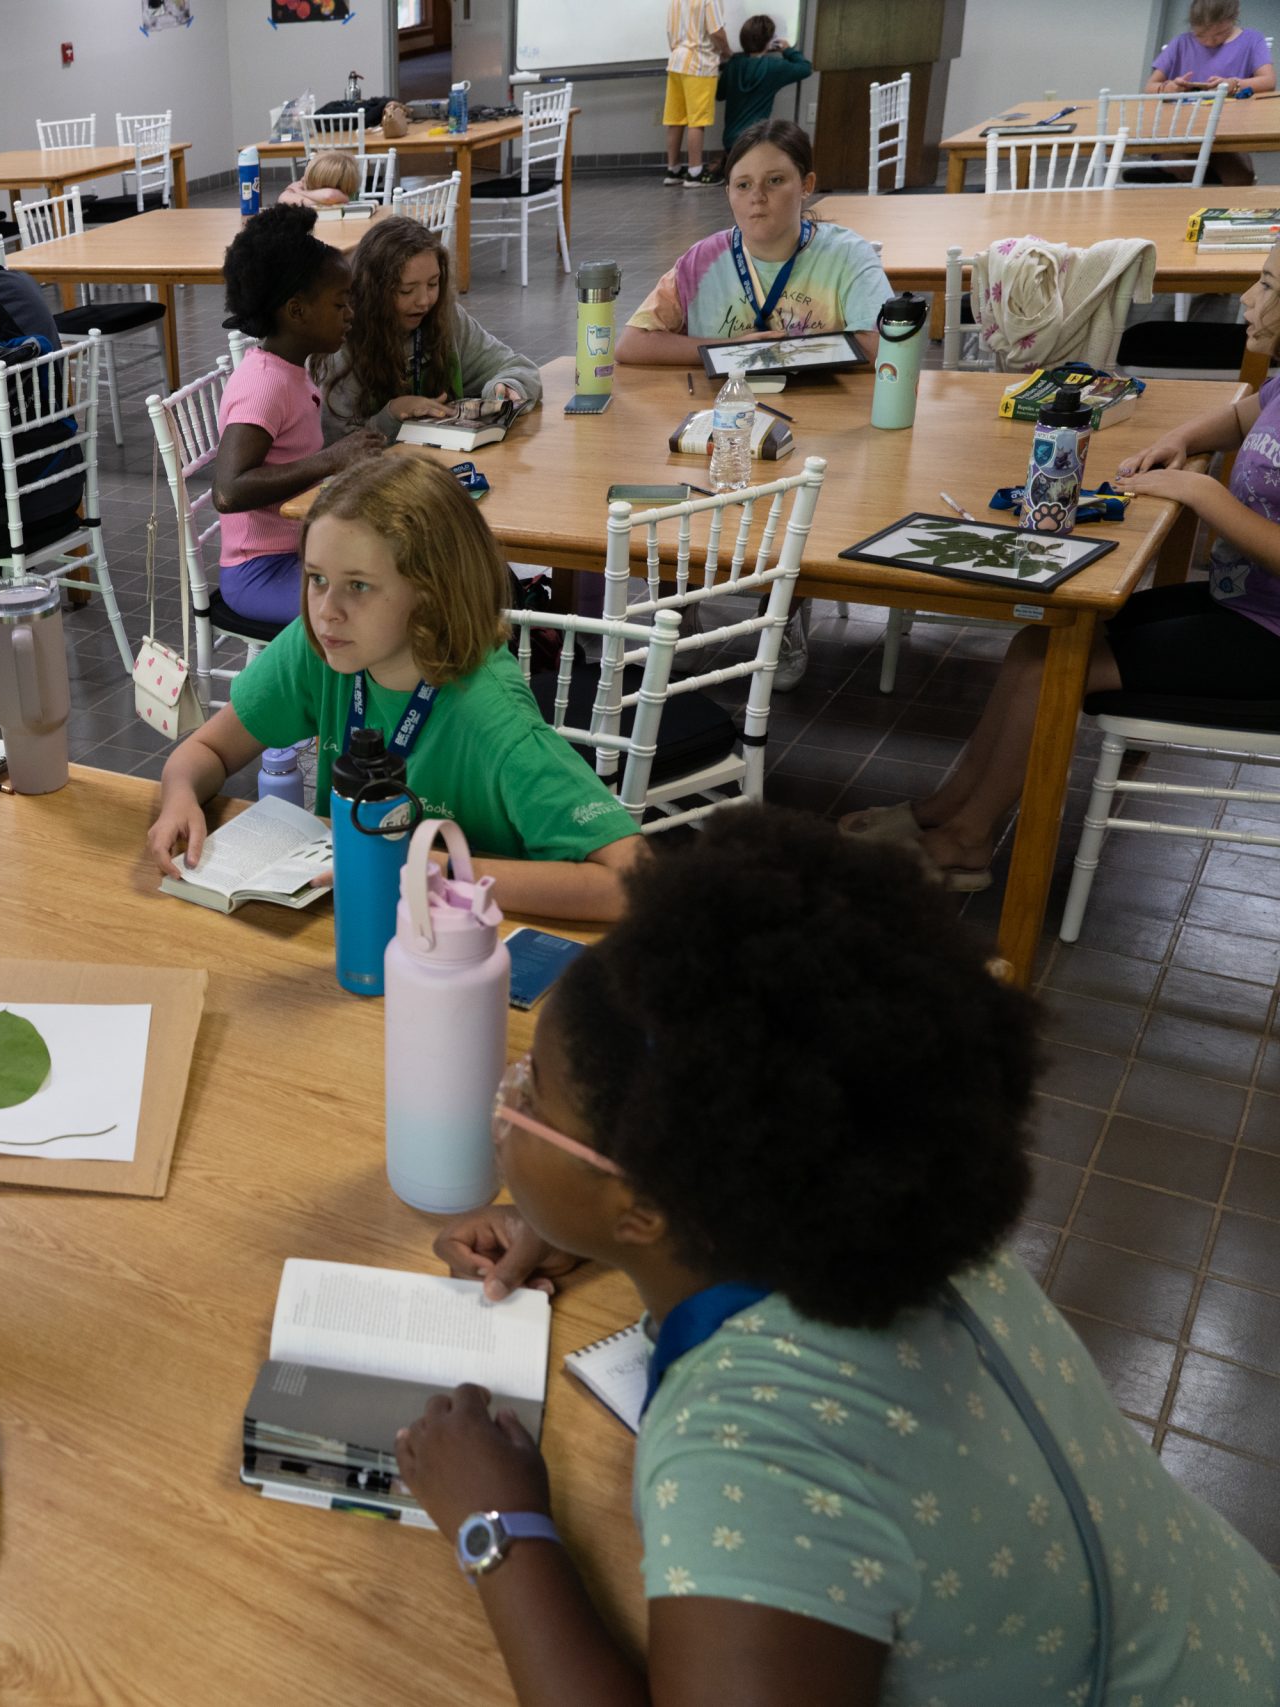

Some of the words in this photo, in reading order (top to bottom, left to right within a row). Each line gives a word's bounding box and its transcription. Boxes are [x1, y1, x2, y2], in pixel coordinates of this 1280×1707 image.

[782, 290, 812, 305] AKER
[718, 305, 757, 338] Mira
[394, 731, 406, 746] BE
[400, 708, 417, 733] BOLD
